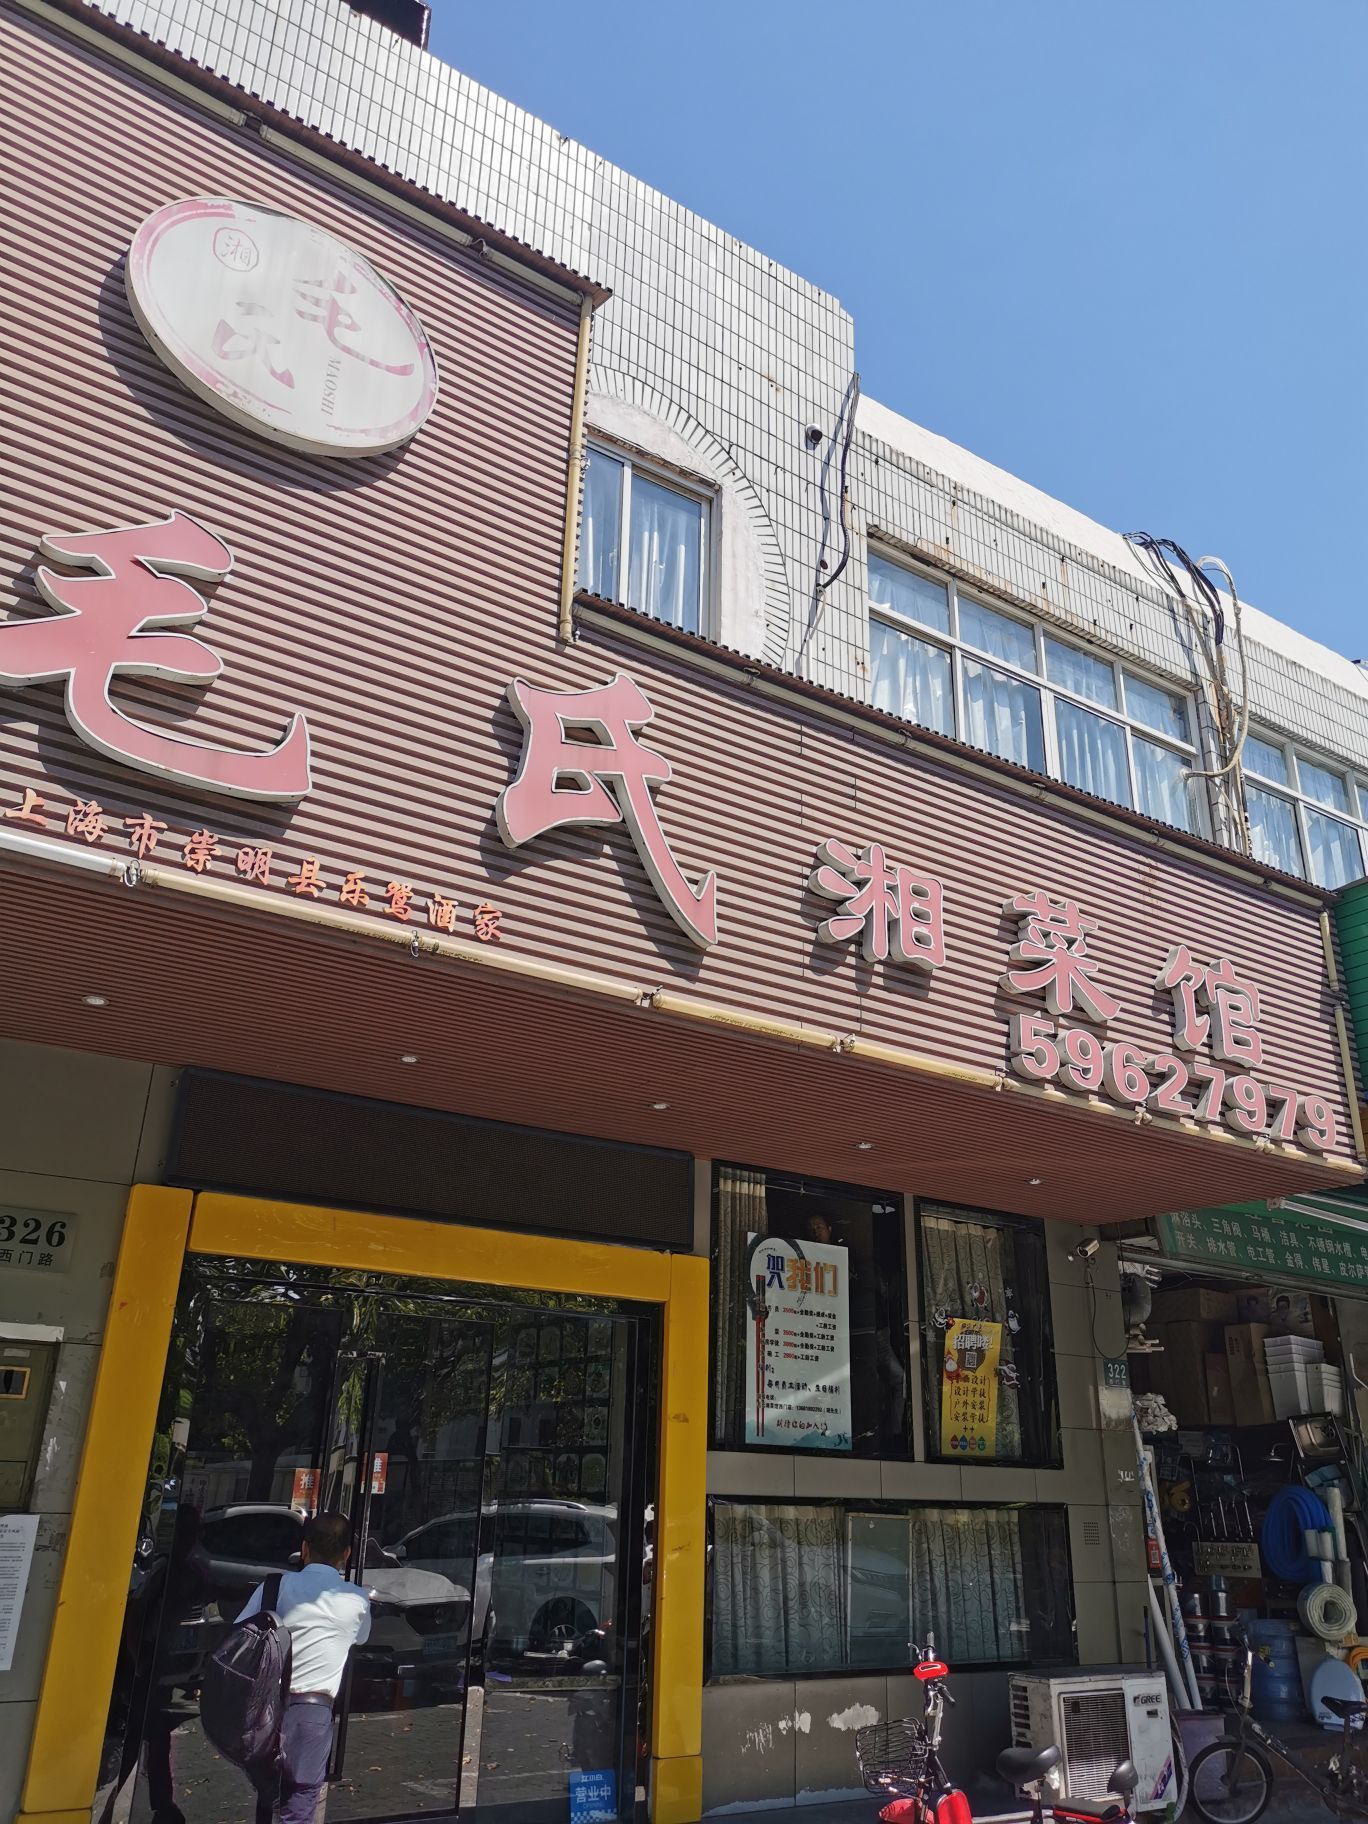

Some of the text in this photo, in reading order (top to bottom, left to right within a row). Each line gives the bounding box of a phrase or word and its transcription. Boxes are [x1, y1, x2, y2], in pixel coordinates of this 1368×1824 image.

[320, 357, 342, 416] MAOSHI
[0, 509, 1262, 1067] 毛氏湘菜馆
[1008, 1013, 1337, 1151] 59627979
[0, 1215, 66, 1248] 326
[0, 1249, 54, 1266] 西门路
[766, 1254, 838, 1297] 加入我们
[1107, 1363, 1127, 1379] 322
[300, 1473, 314, 1489] 推
[1141, 1695, 1161, 1705] GREE
[575, 1784, 611, 1804] 营业中
